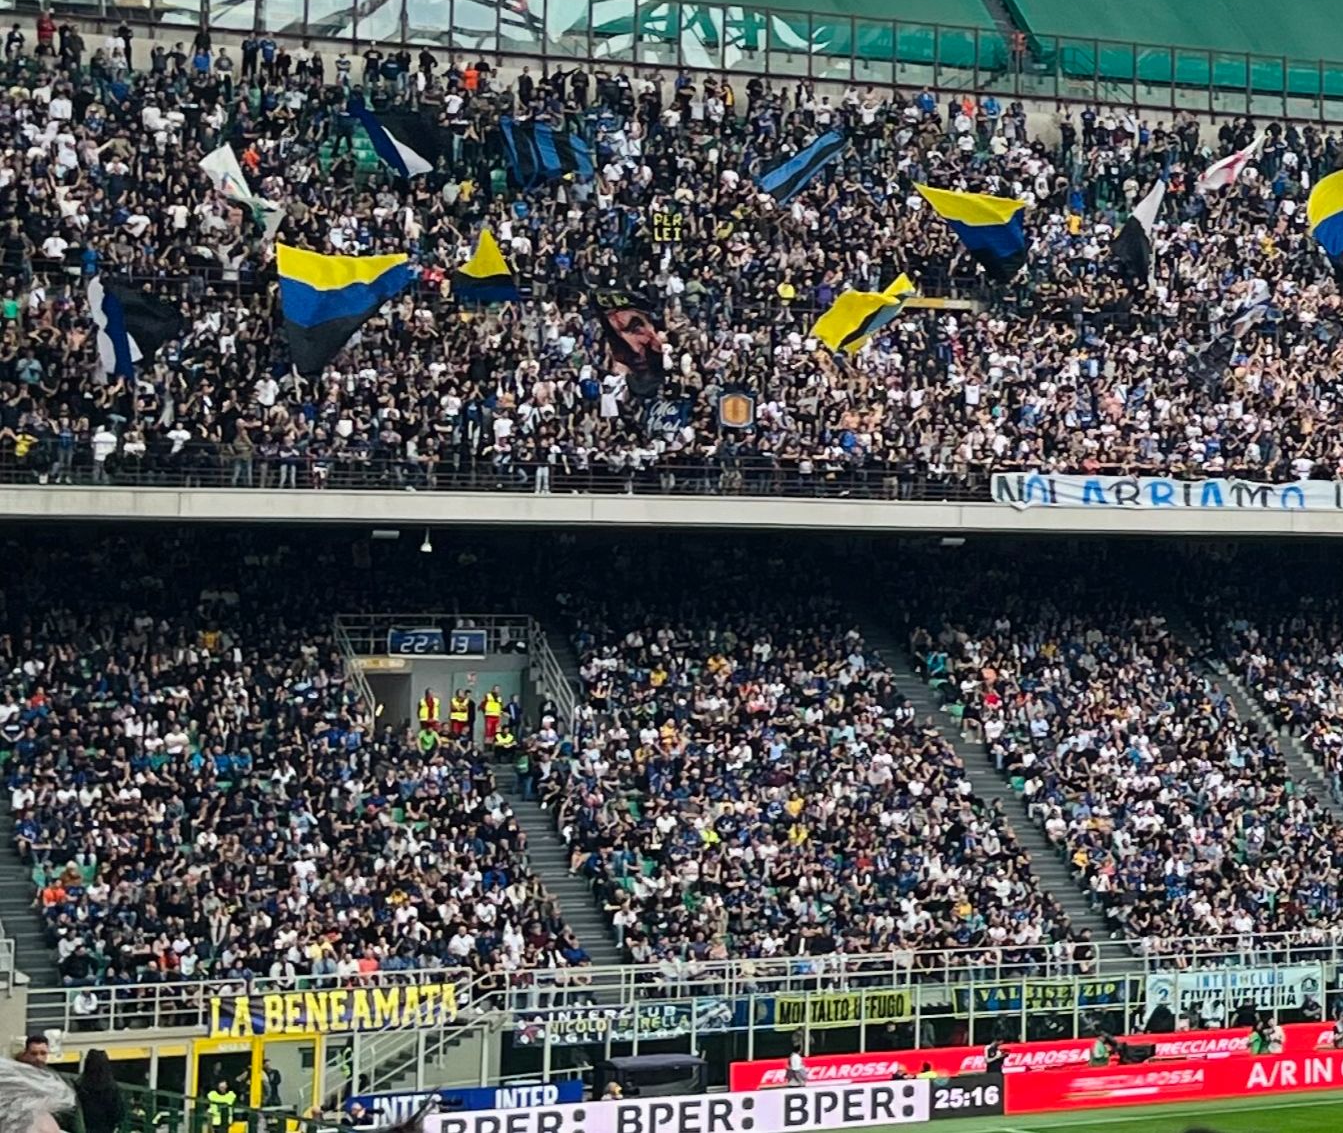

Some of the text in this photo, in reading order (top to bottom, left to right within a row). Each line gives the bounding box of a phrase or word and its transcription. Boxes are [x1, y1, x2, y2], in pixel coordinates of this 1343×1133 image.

[654, 213, 683, 227] PER
[654, 228, 682, 241] LEI
[210, 983, 458, 1038] LA BENEAMATA
[618, 1014, 690, 1032] BRELLA
[960, 1048, 1091, 1069] FRCIAROSSA
[760, 1060, 898, 1084] FRCIAROSSA
[1248, 1054, 1297, 1088] A/R
[1305, 1054, 1334, 1085] IN
[495, 1085, 559, 1110] INTER
[933, 1084, 999, 1109] 25:16
